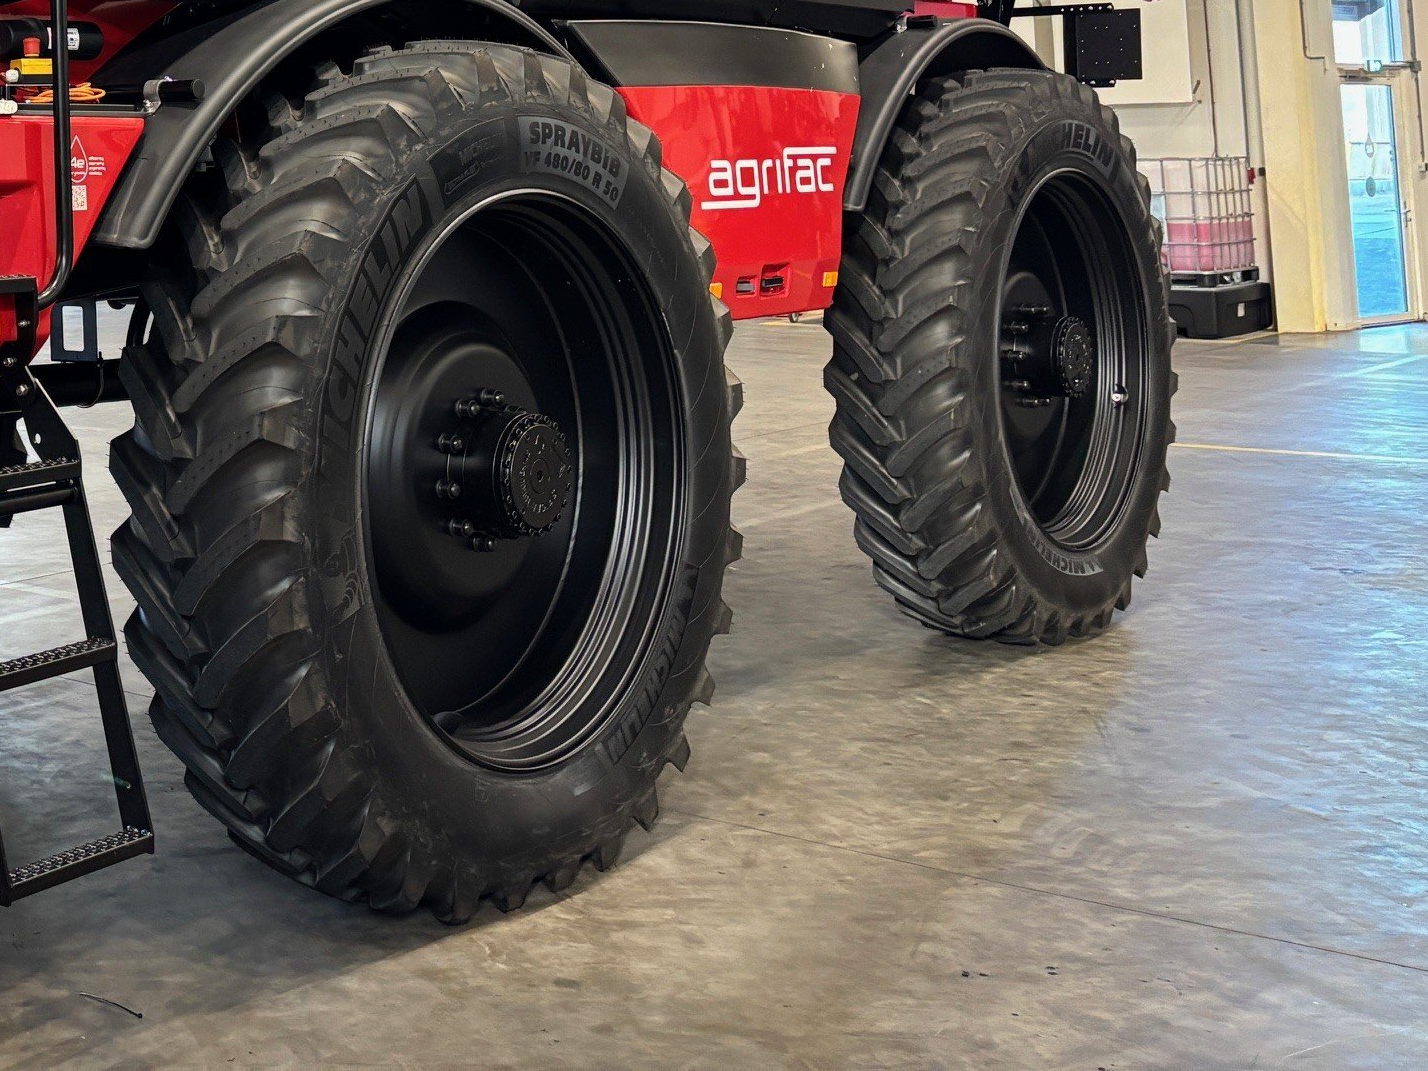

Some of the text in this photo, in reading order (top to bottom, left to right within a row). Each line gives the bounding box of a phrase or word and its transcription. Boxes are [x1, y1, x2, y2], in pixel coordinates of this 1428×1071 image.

[529, 121, 622, 179] SPRAYBIB
[544, 151, 591, 181] 480/80
[592, 170, 603, 189] R
[603, 179, 619, 202] 50
[700, 146, 838, 211] agrifac
